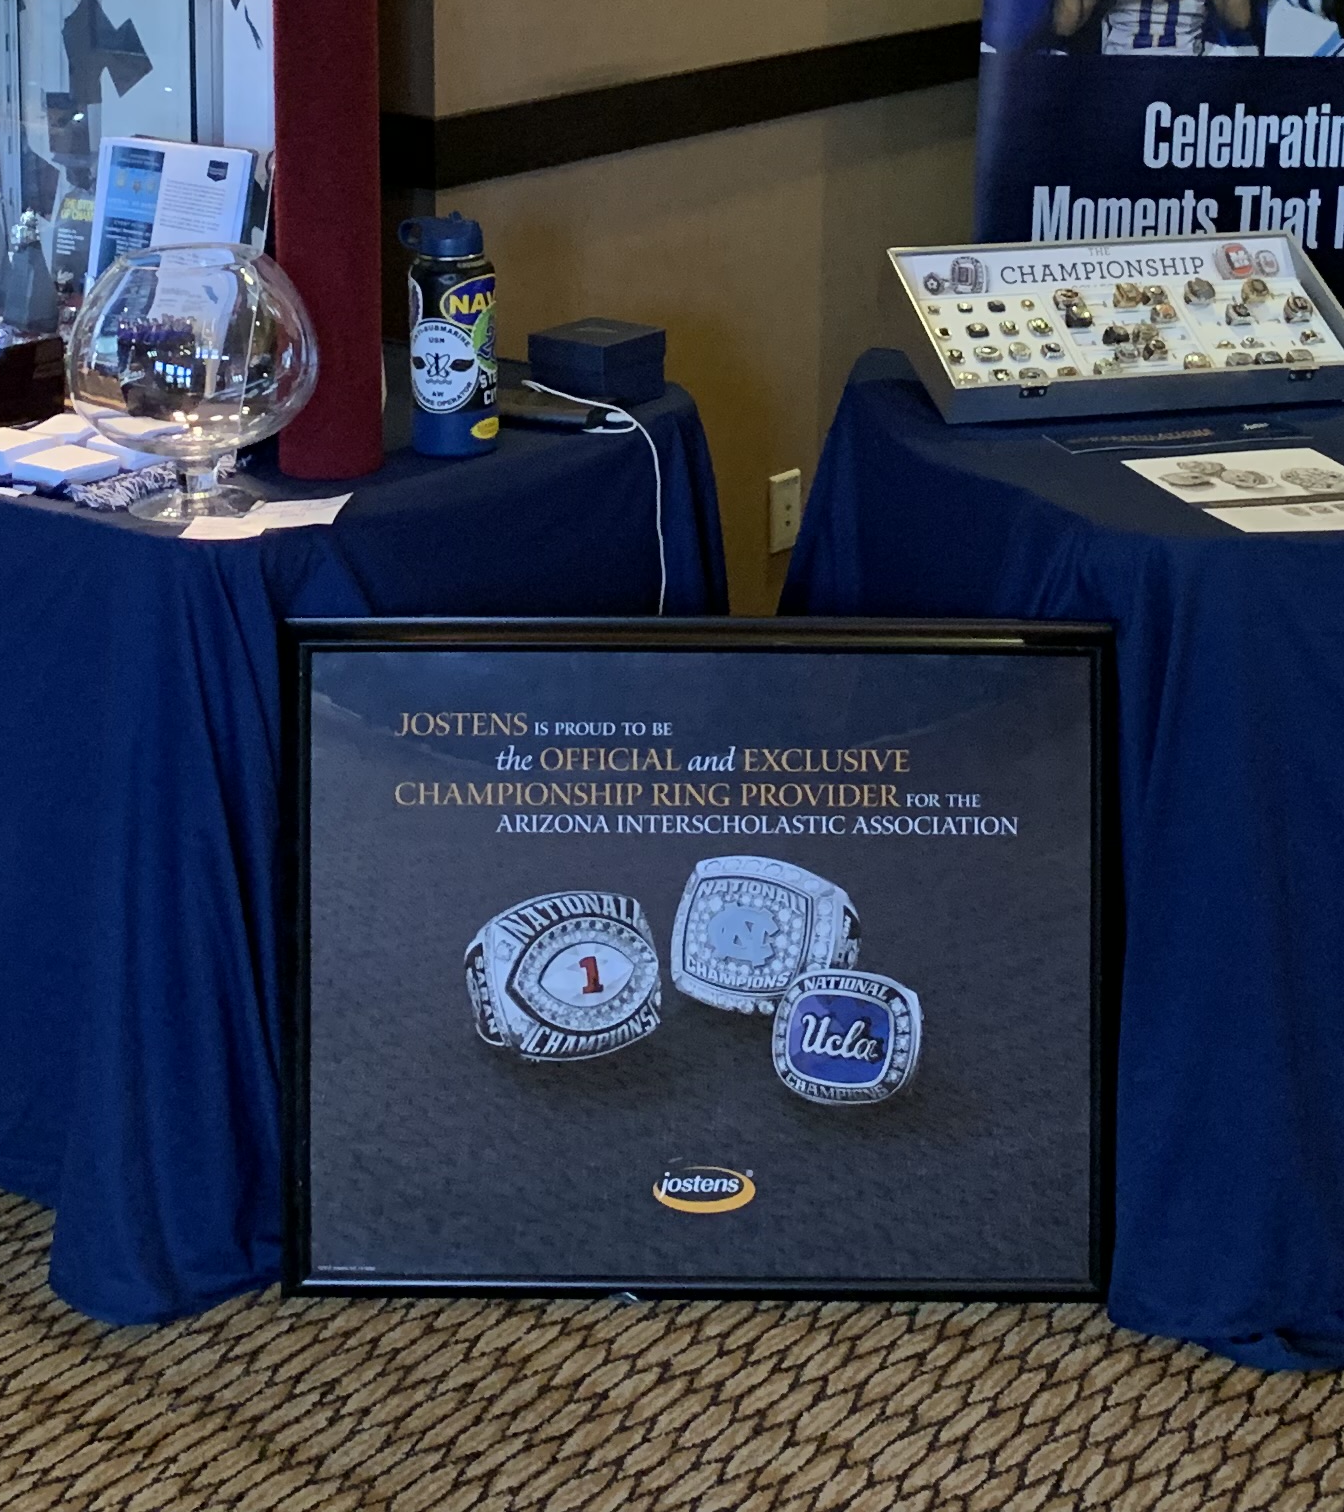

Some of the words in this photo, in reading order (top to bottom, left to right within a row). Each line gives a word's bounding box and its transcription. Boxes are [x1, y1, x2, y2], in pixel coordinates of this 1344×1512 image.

[1031, 185, 1219, 244] Moments
[1234, 185, 1322, 250] That
[999, 256, 1205, 285] CHAMPIONSHIP
[395, 712, 528, 738] JOSTENS
[534, 721, 549, 737] IS
[555, 721, 616, 737] PROUD
[621, 721, 646, 737] TO
[652, 721, 673, 737] BE
[495, 745, 533, 772] the
[540, 746, 682, 772] OFFICIAL
[687, 746, 737, 772] and
[743, 748, 911, 773] EXCLUSIVE
[394, 782, 644, 807] CHAMPIONSHIP
[651, 782, 731, 808] RING
[740, 783, 902, 808] PROVIDER
[906, 793, 942, 808] FOR
[946, 793, 982, 808] THE
[495, 814, 611, 834] ARIZONA
[616, 814, 847, 835] INTERSCHOLASTIC
[851, 815, 1020, 836] ASSOCIATION
[578, 955, 605, 995] 1
[686, 956, 791, 988] CHAMPIONS
[803, 976, 889, 1000] NATIONAL
[658, 1171, 740, 1199] jostens
